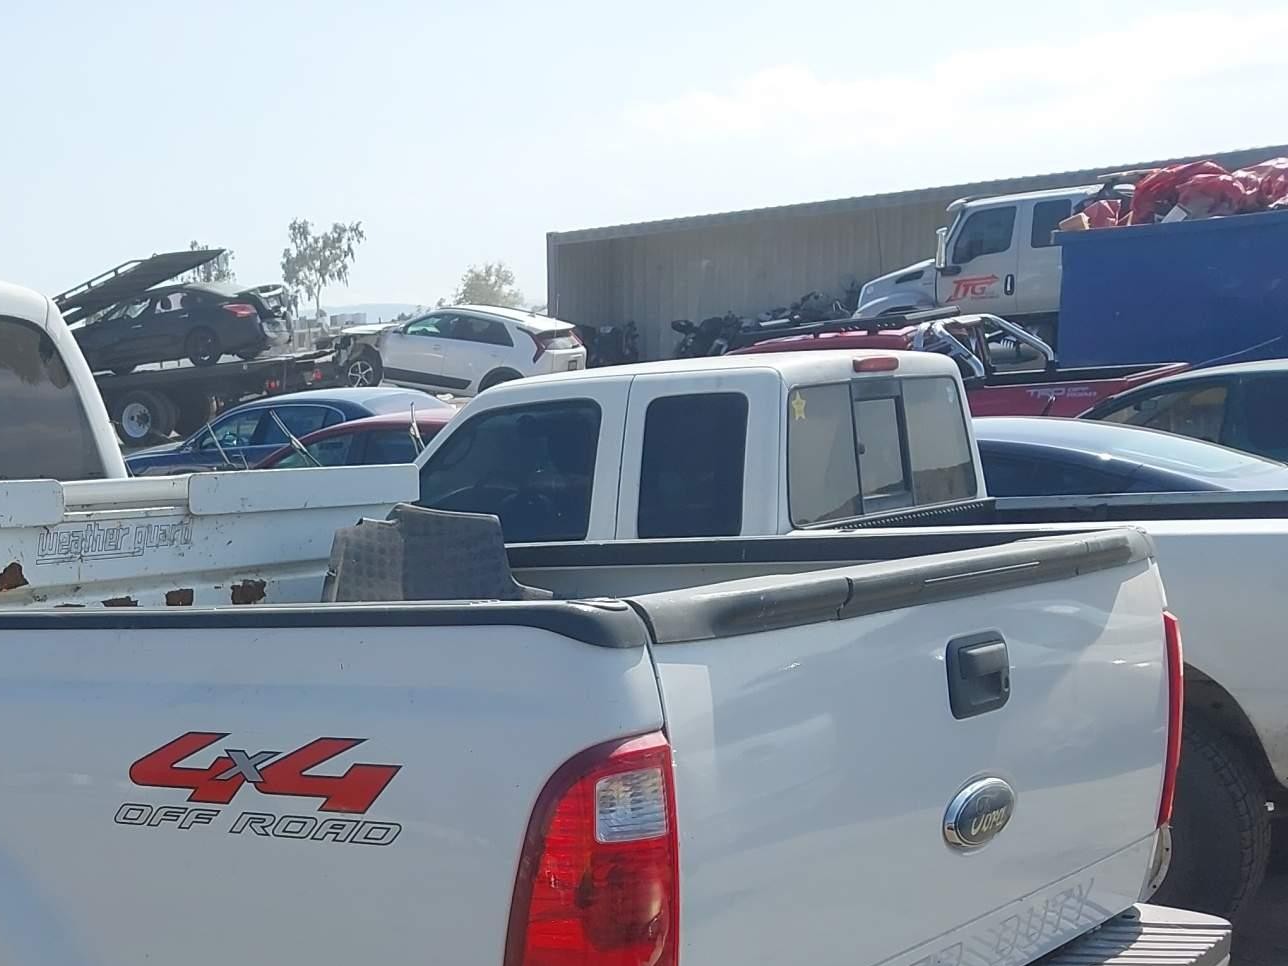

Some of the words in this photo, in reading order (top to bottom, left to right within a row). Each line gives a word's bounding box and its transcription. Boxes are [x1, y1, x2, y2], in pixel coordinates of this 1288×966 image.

[38, 522, 130, 557] weather
[133, 517, 194, 556] guard
[114, 802, 221, 830] OFF
[228, 811, 403, 847] ROAD
